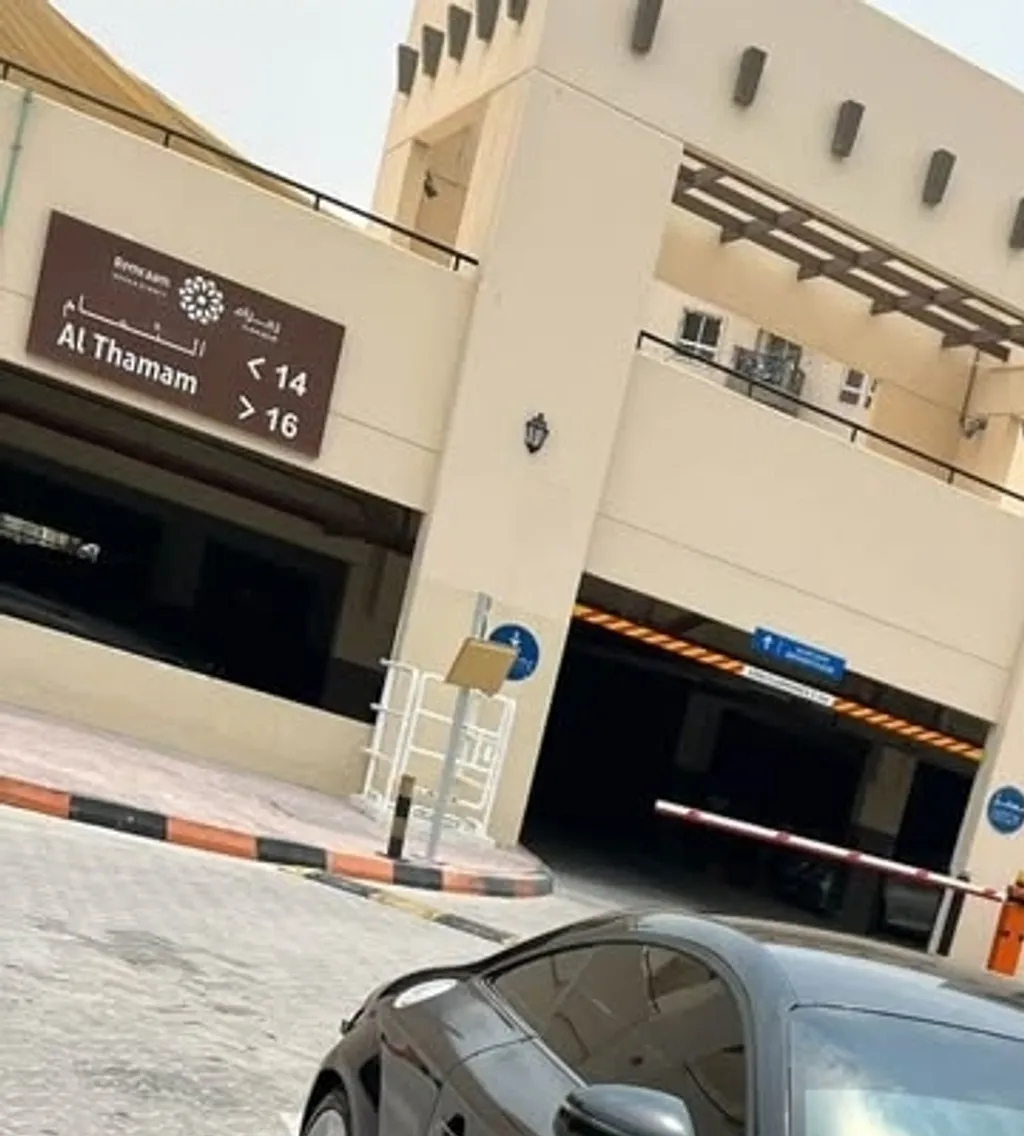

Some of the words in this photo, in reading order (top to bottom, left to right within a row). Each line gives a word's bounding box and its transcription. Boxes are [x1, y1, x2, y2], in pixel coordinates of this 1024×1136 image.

[56, 322, 85, 354] Al
[93, 332, 198, 394] Thamam
[275, 364, 308, 397] 14
[265, 407, 299, 439] 16
